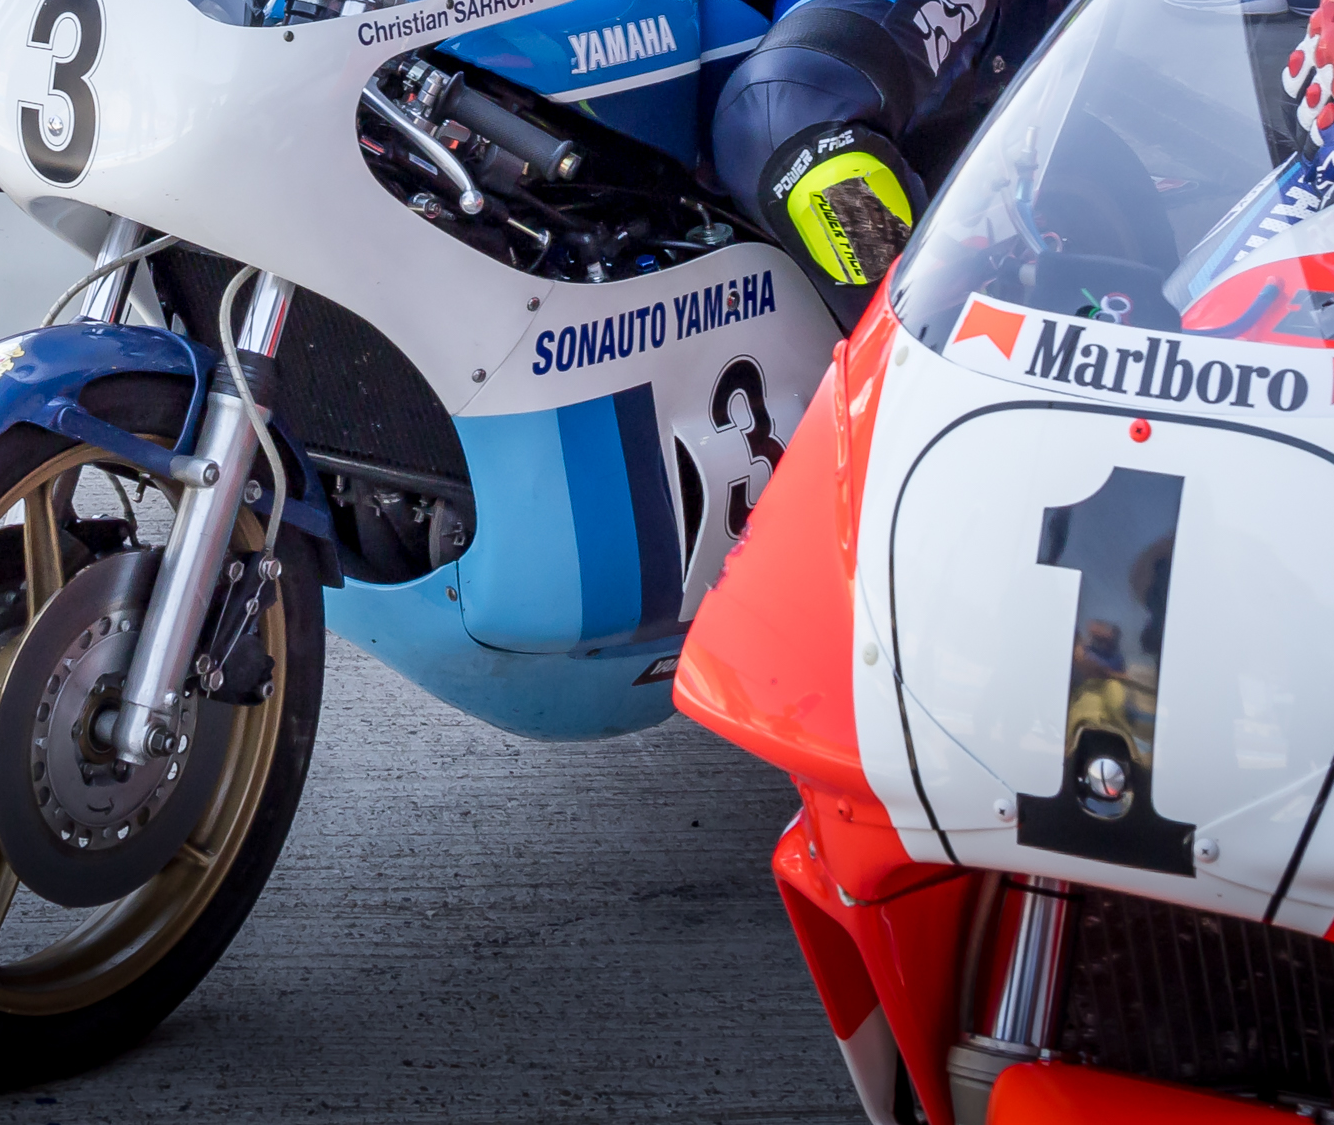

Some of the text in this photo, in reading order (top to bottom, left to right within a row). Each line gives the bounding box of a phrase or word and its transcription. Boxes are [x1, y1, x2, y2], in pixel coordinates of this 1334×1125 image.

[357, 6, 450, 47] Christian
[569, 14, 678, 74] YAMAHA
[772, 149, 814, 200] POWER
[813, 194, 843, 238] POWER
[531, 269, 779, 377] SONAUTO YAMAHA
[1024, 318, 1309, 414] Marlboro
[1016, 465, 1197, 880] 1
